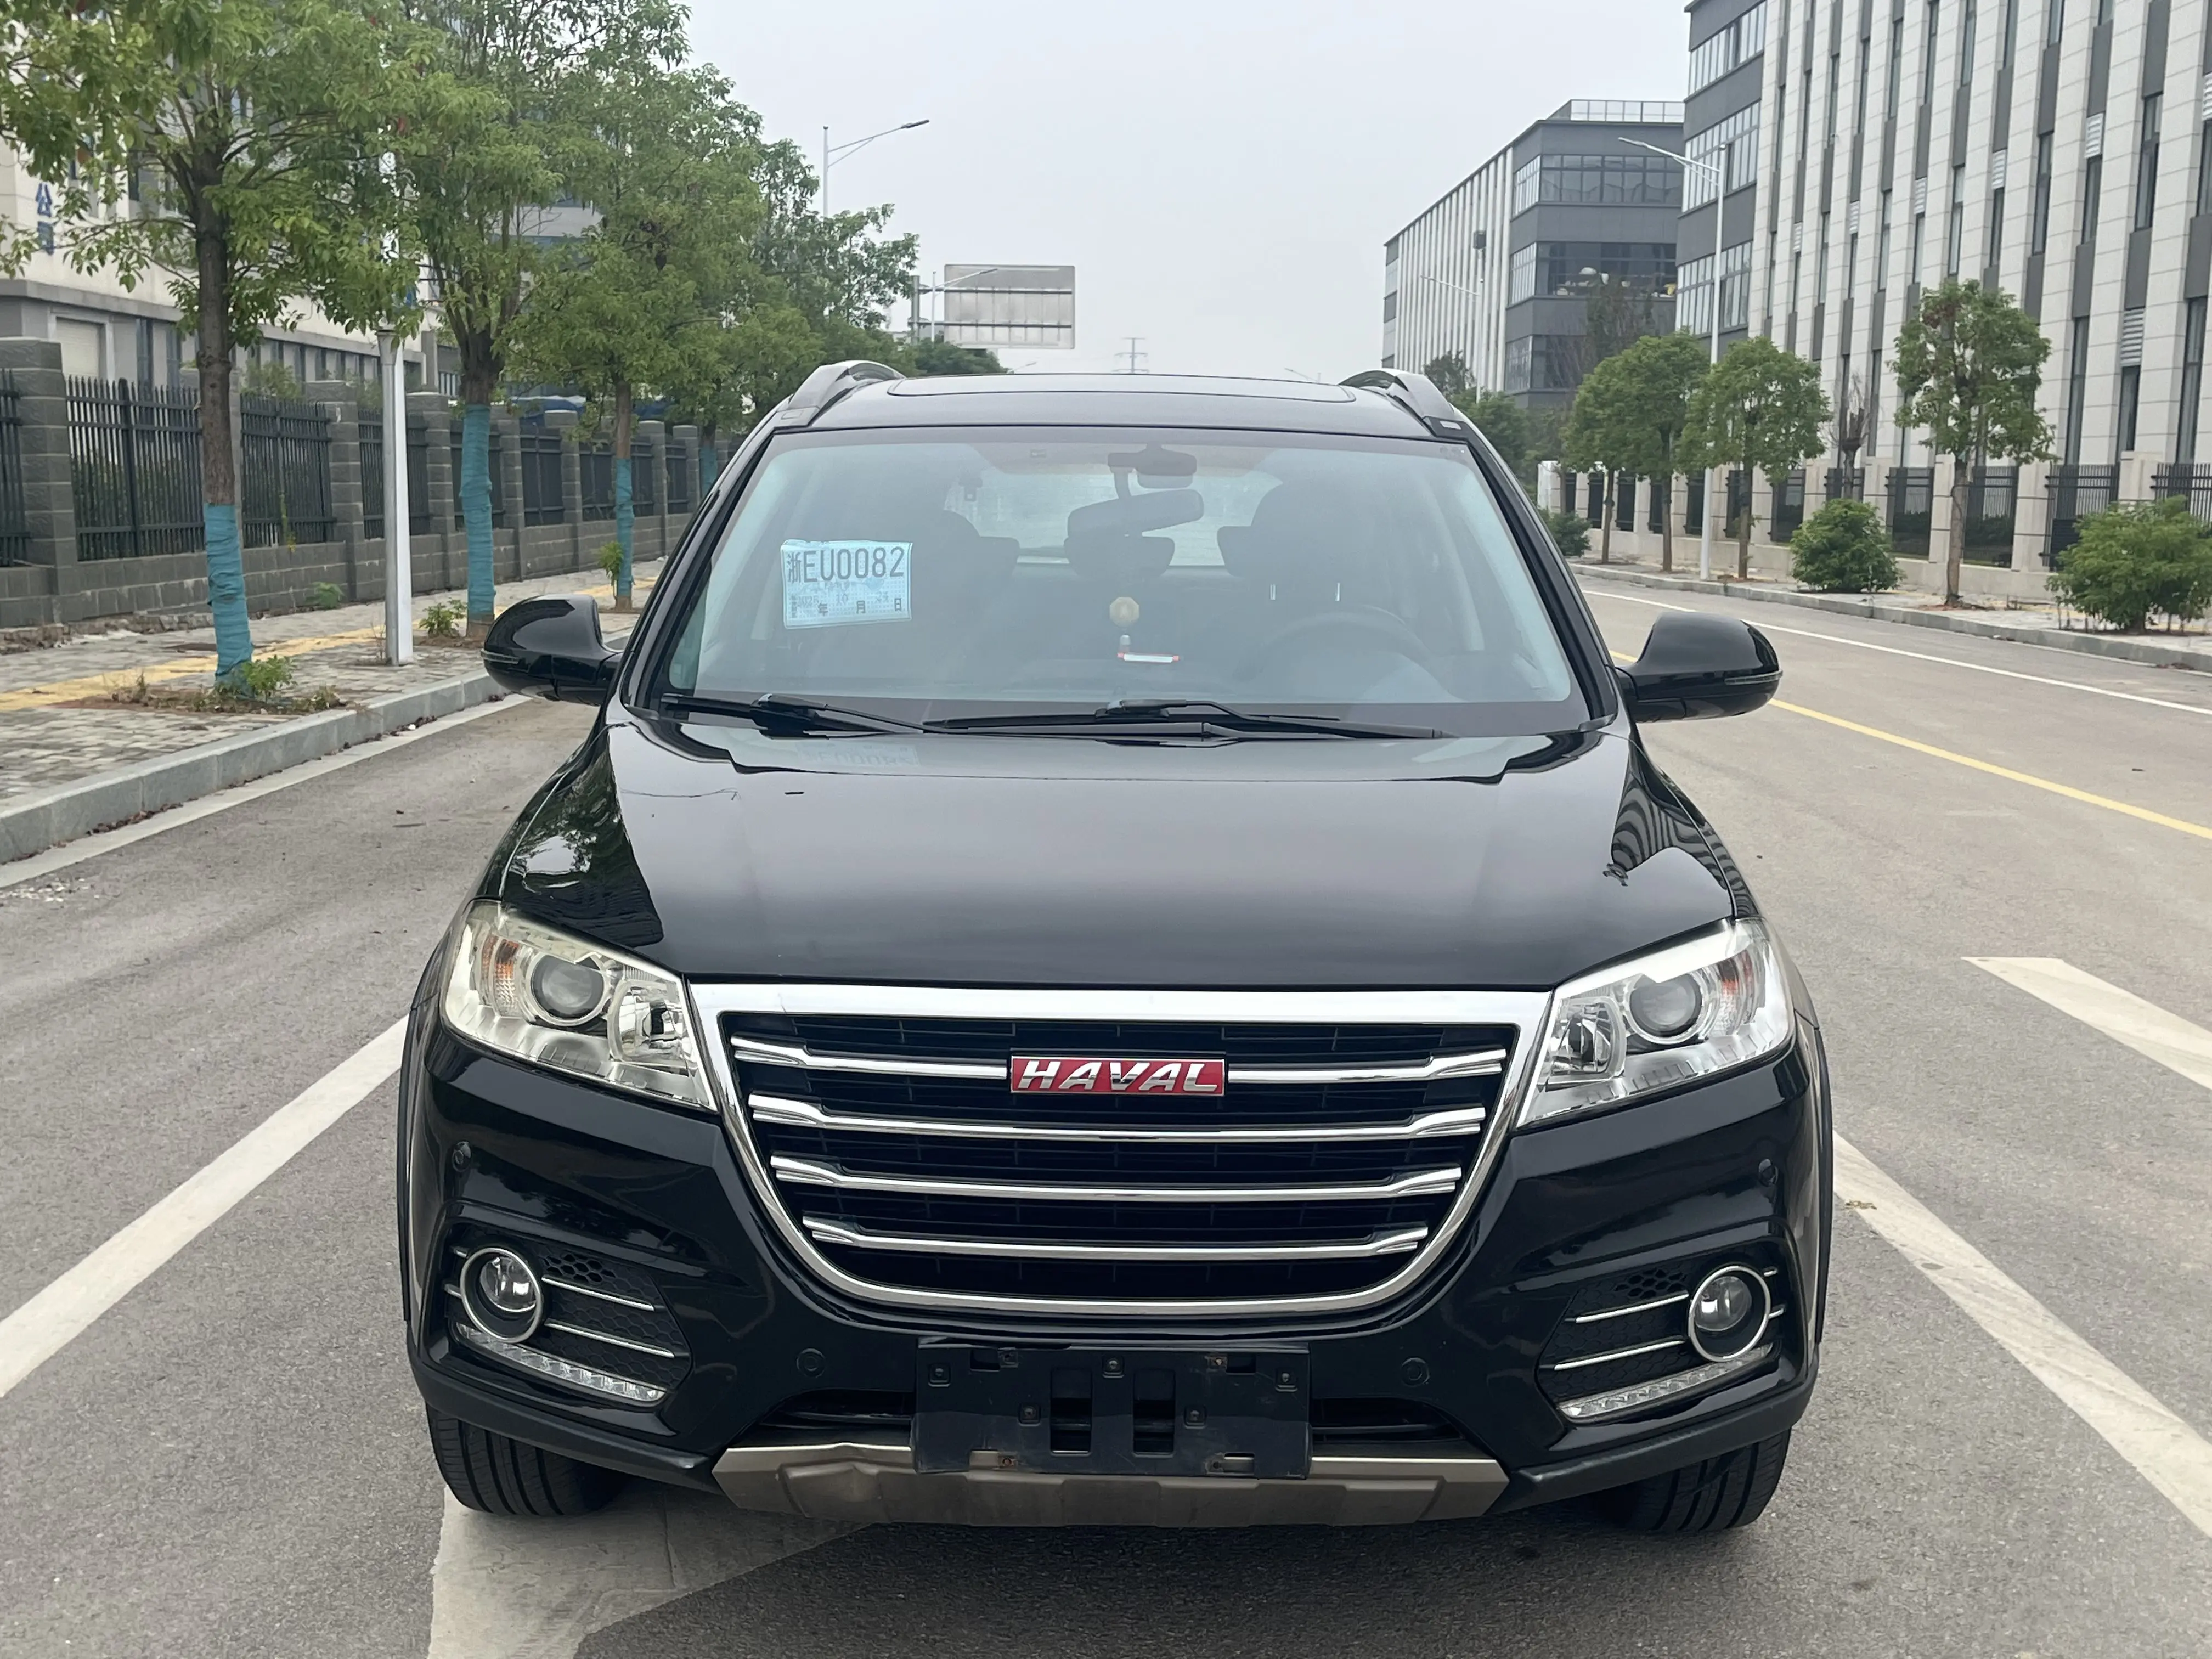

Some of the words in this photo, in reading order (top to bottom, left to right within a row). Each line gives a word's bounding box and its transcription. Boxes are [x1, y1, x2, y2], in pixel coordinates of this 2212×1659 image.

[787, 546, 905, 583] 浙EU0082
[817, 603, 828, 616] 年
[856, 600, 866, 614] 月
[894, 597, 902, 611] 日
[1018, 1060, 1217, 1092] HAVAL
